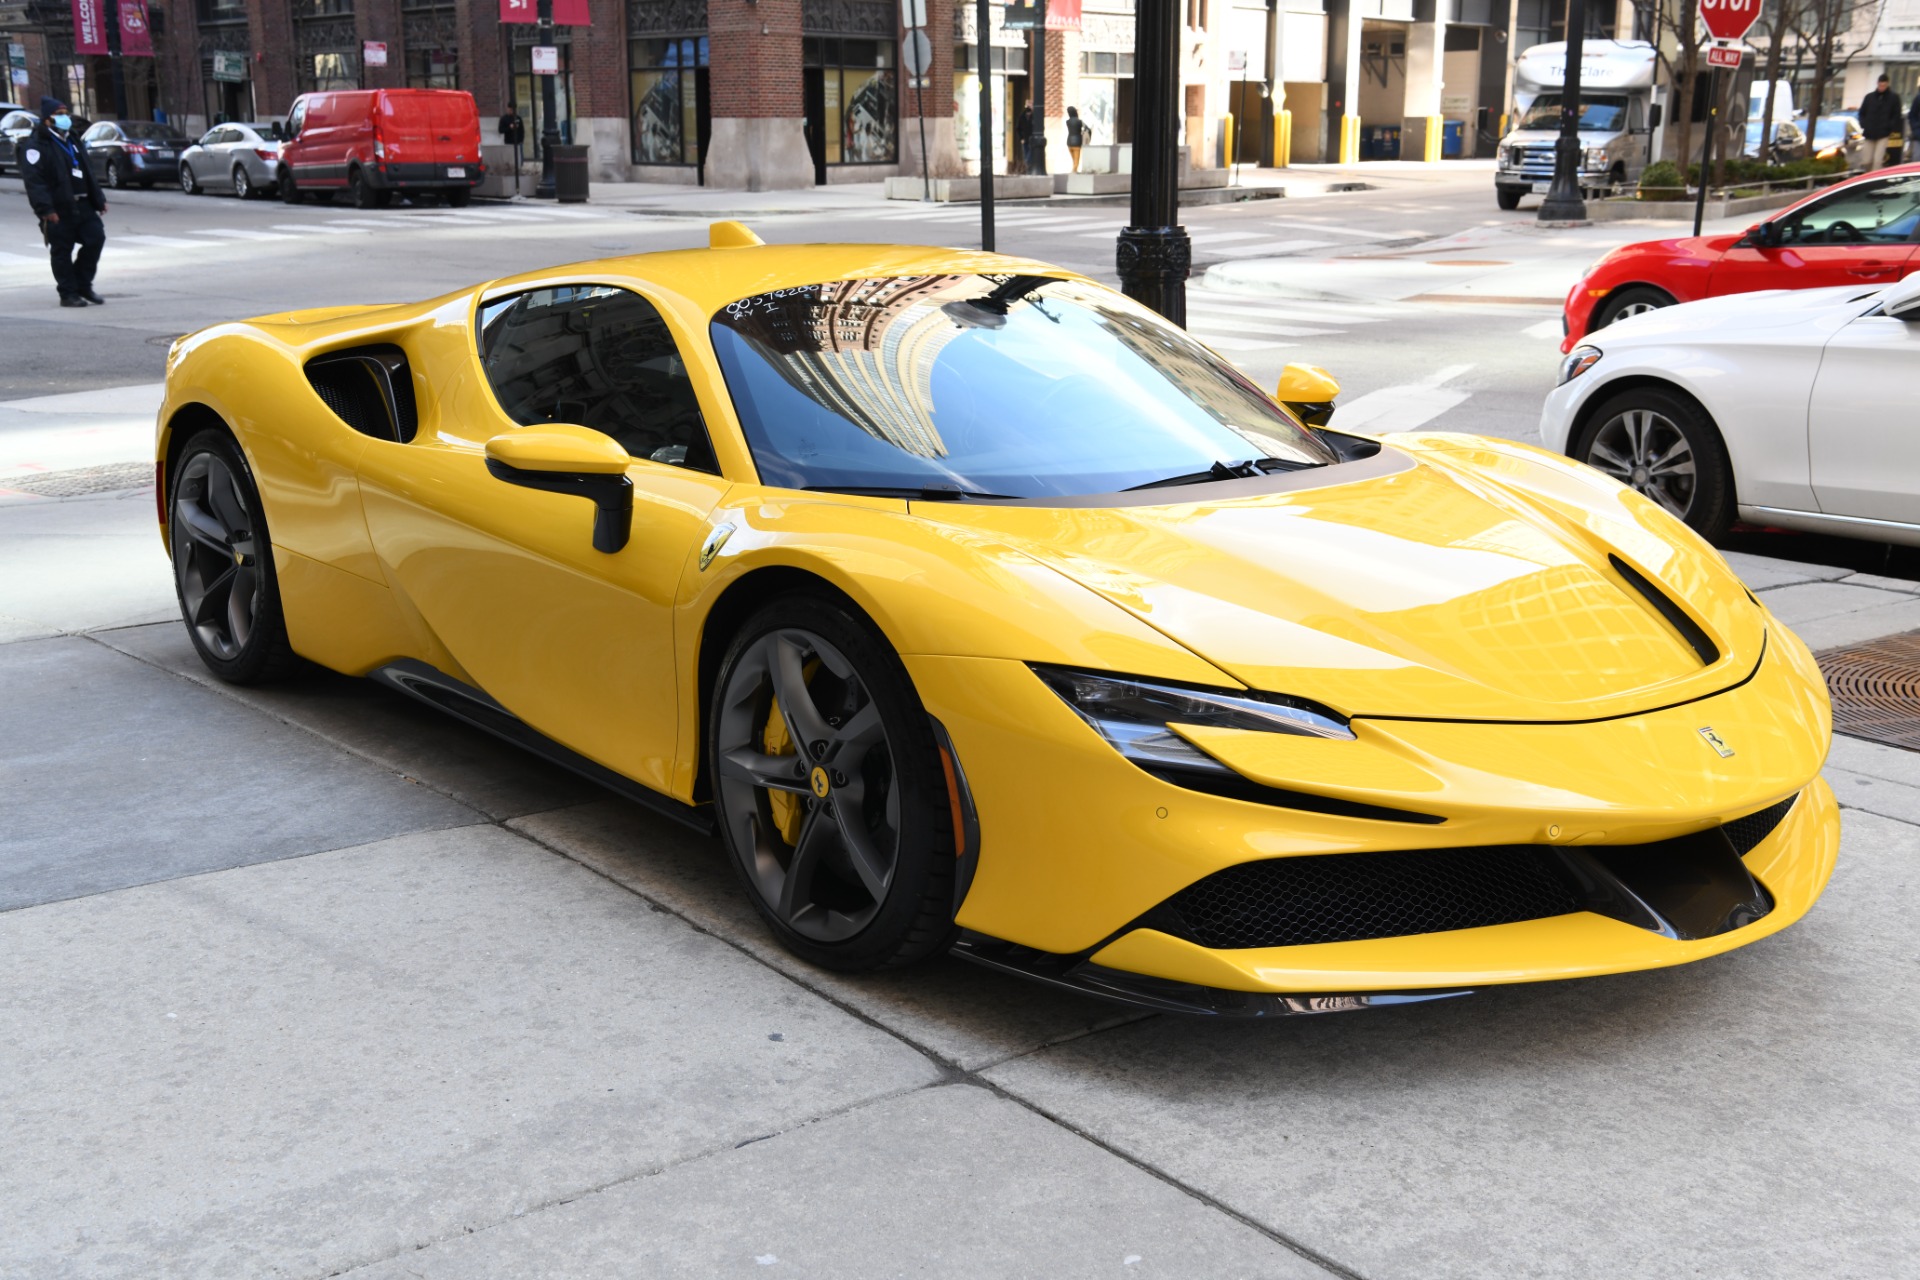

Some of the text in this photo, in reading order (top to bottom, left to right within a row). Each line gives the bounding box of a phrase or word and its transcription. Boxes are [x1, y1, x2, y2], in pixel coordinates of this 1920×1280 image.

[79, 0, 93, 44] WELCO
[1710, 50, 1739, 63] ALL WAY
